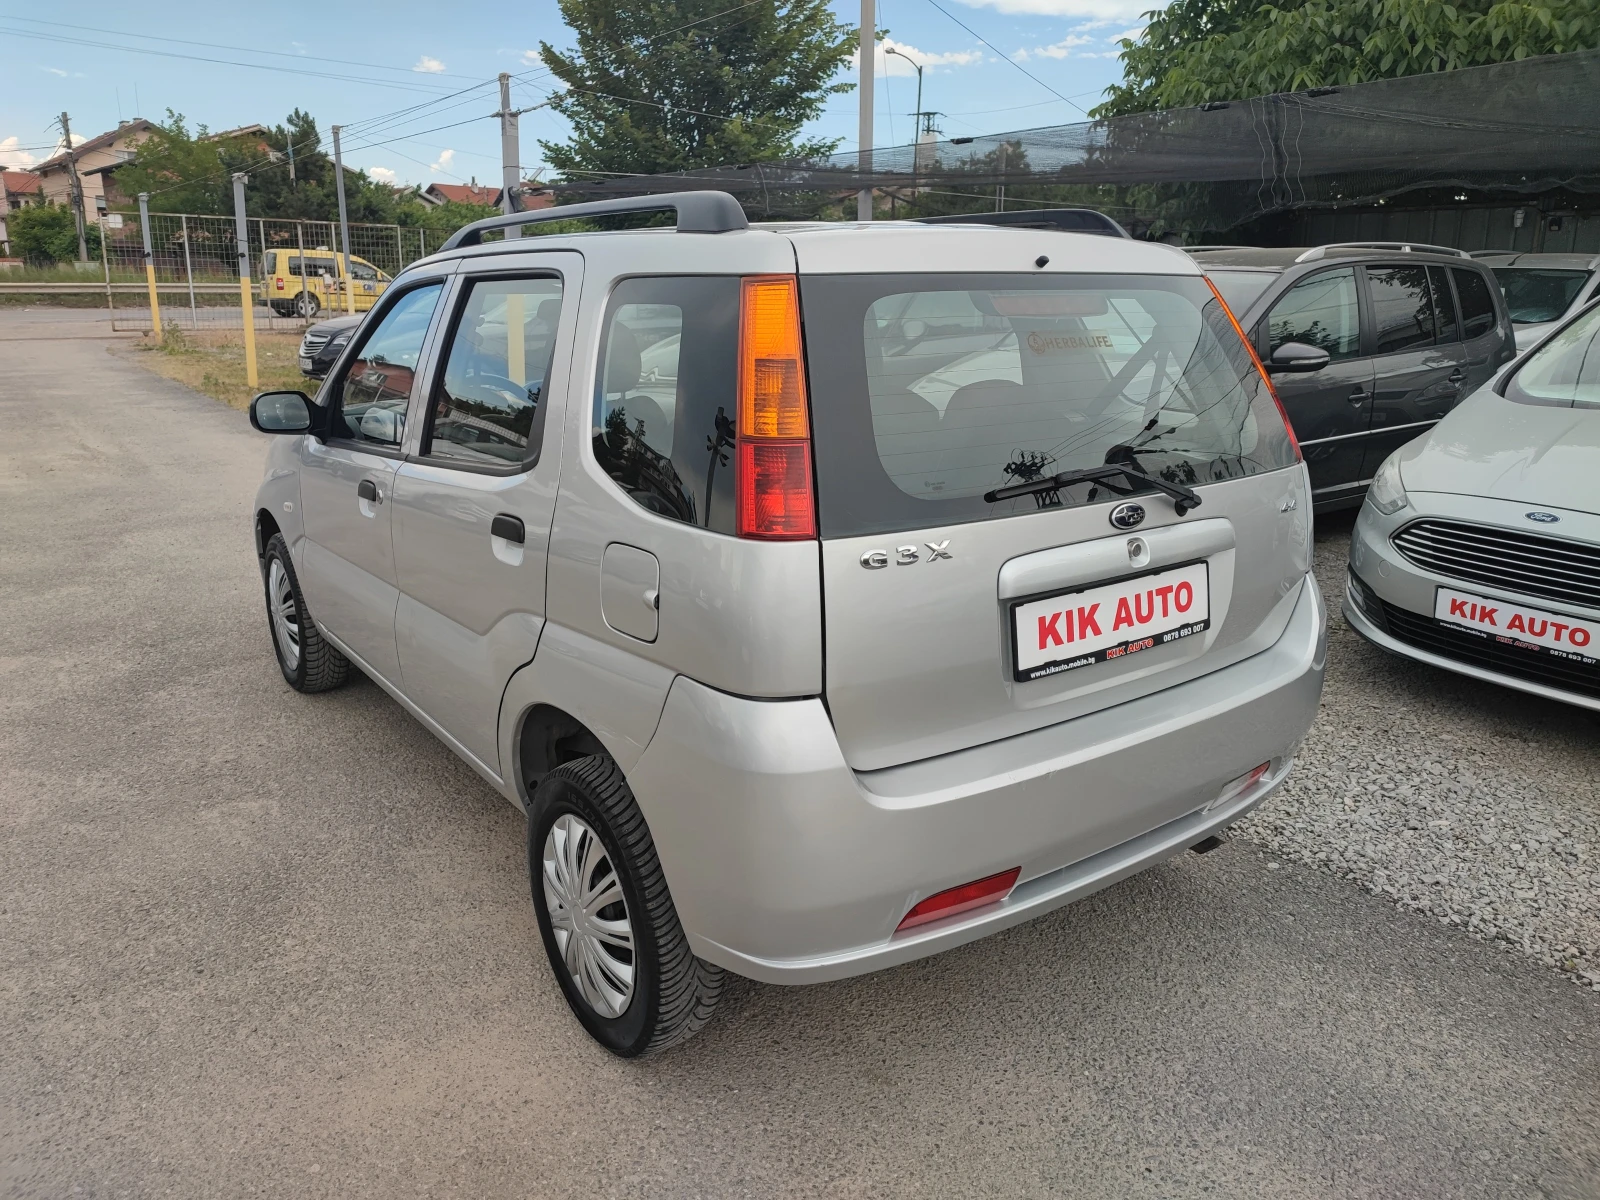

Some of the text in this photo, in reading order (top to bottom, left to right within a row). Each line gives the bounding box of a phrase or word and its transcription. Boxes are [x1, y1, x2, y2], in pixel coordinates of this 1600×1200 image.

[1044, 336, 1113, 349] HERBALIFE
[1529, 512, 1554, 522] Ford
[1037, 581, 1193, 650] KIK AUTO
[1449, 598, 1591, 647] KIK AUTO
[1163, 623, 1204, 642] 0878 693 007
[1106, 638, 1154, 660] KIK AUTO
[1495, 635, 1540, 651] KIK AUTO
[1549, 649, 1567, 658] 0878
[1030, 657, 1096, 679] www.kikauto.mobile.bg
